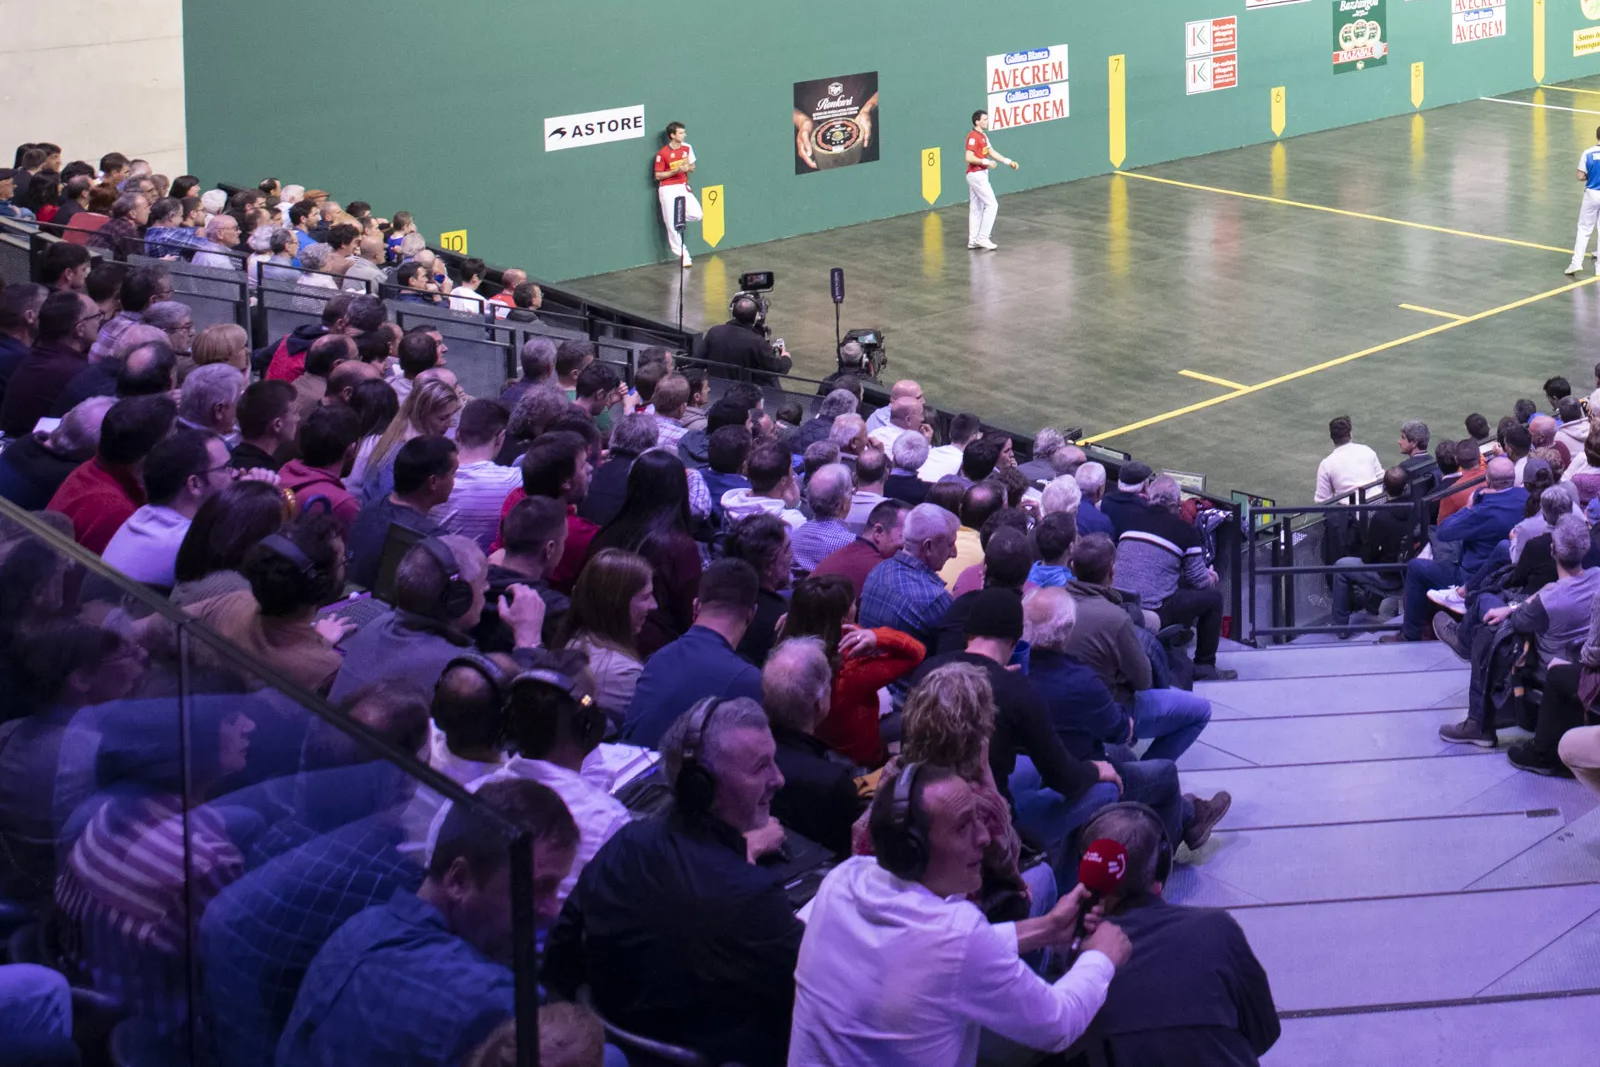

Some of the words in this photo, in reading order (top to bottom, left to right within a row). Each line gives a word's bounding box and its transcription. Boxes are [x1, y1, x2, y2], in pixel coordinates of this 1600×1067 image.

[1455, 19, 1502, 42] AVECREM
[1006, 52, 1028, 64] Gallina
[1028, 49, 1048, 62] Blanca
[1114, 58, 1120, 72] 7
[1414, 66, 1420, 78] 5
[992, 61, 1064, 91] AVECREM
[1007, 90, 1028, 102] Gallina
[1029, 88, 1050, 100] Blanca
[1274, 90, 1282, 104] 6
[992, 98, 1064, 130] AVECREM
[572, 116, 642, 138] ASTORE
[928, 152, 935, 166] 8
[708, 190, 718, 206] 9
[444, 235, 463, 252] 10
